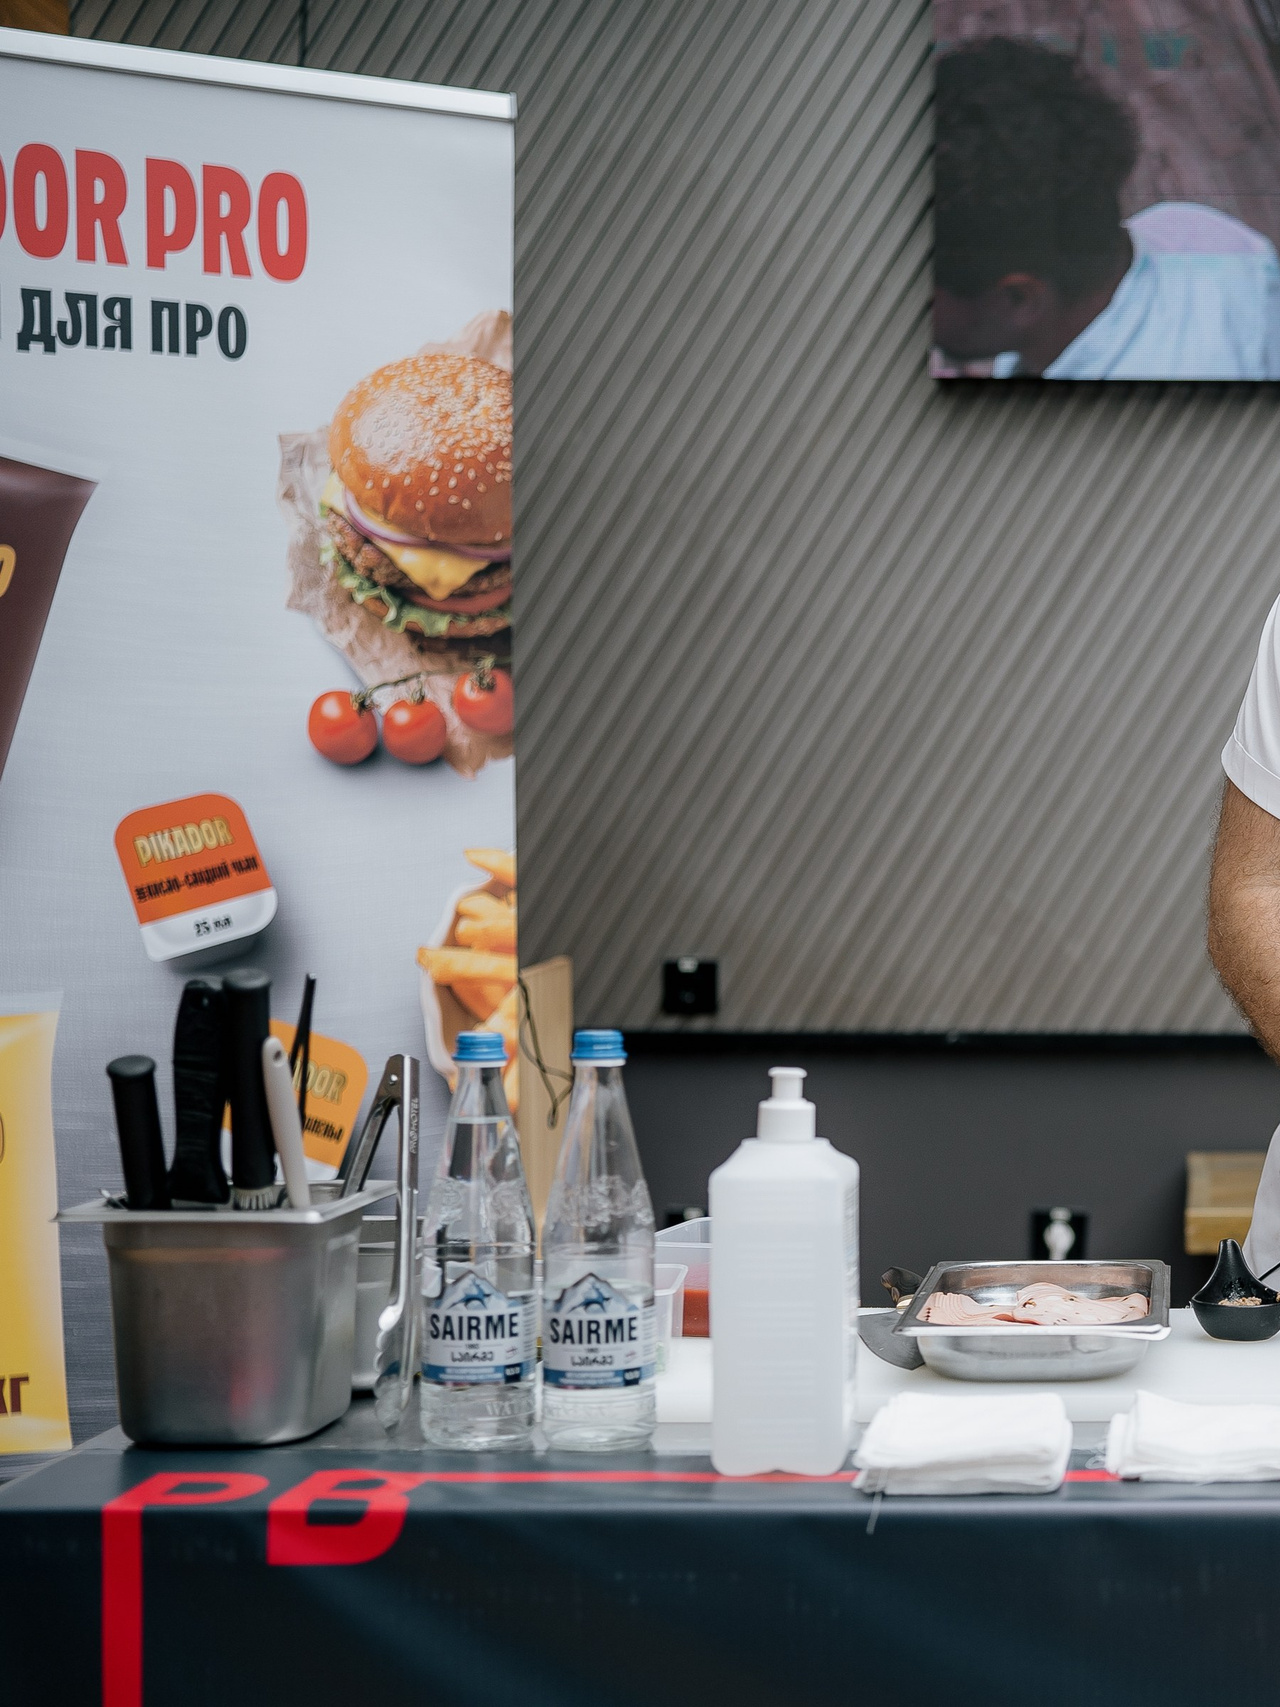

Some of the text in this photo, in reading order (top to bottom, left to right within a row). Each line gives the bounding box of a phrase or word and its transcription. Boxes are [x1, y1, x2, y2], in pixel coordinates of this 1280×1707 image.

[0, 142, 309, 283] OR PRO
[16, 286, 248, 361] ДЛЯ ПРО
[133, 815, 235, 868] PIKADOR
[430, 1313, 519, 1341] SAIRME
[550, 1316, 638, 1345] SAIRME
